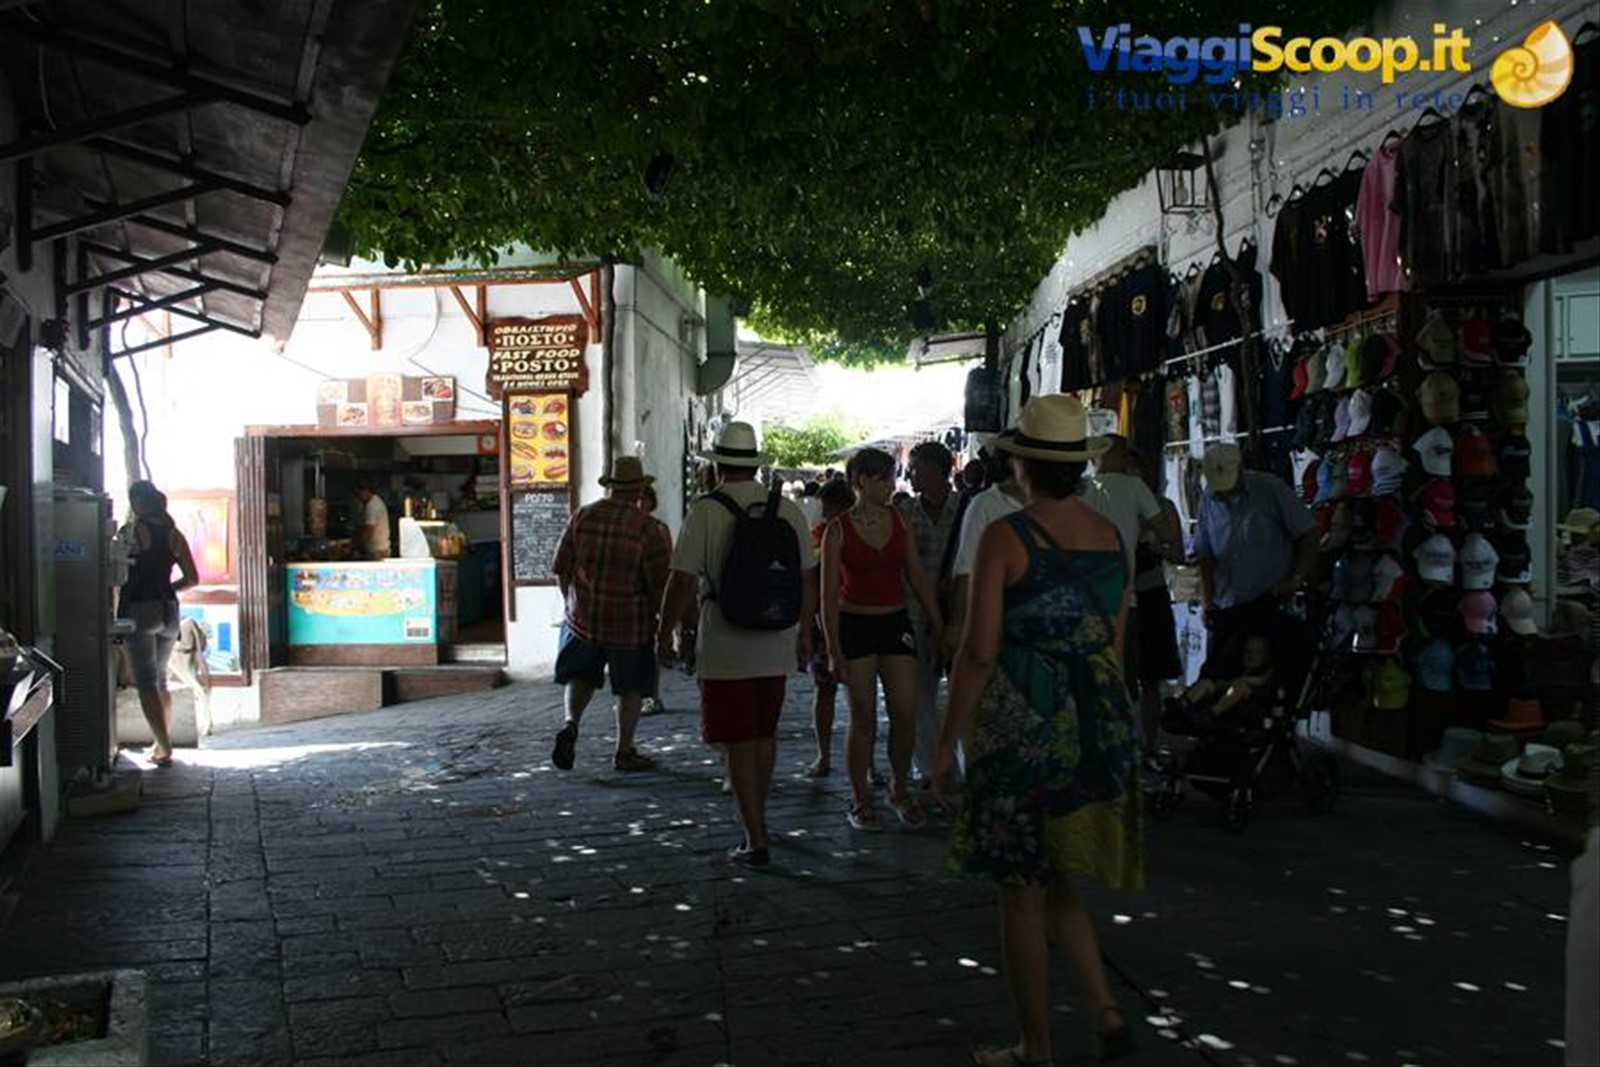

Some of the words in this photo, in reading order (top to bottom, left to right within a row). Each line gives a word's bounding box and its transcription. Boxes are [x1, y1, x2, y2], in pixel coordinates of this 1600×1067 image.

[492, 351, 530, 360] FAST
[536, 349, 579, 358] FOOD
[501, 360, 569, 373] POSTO
